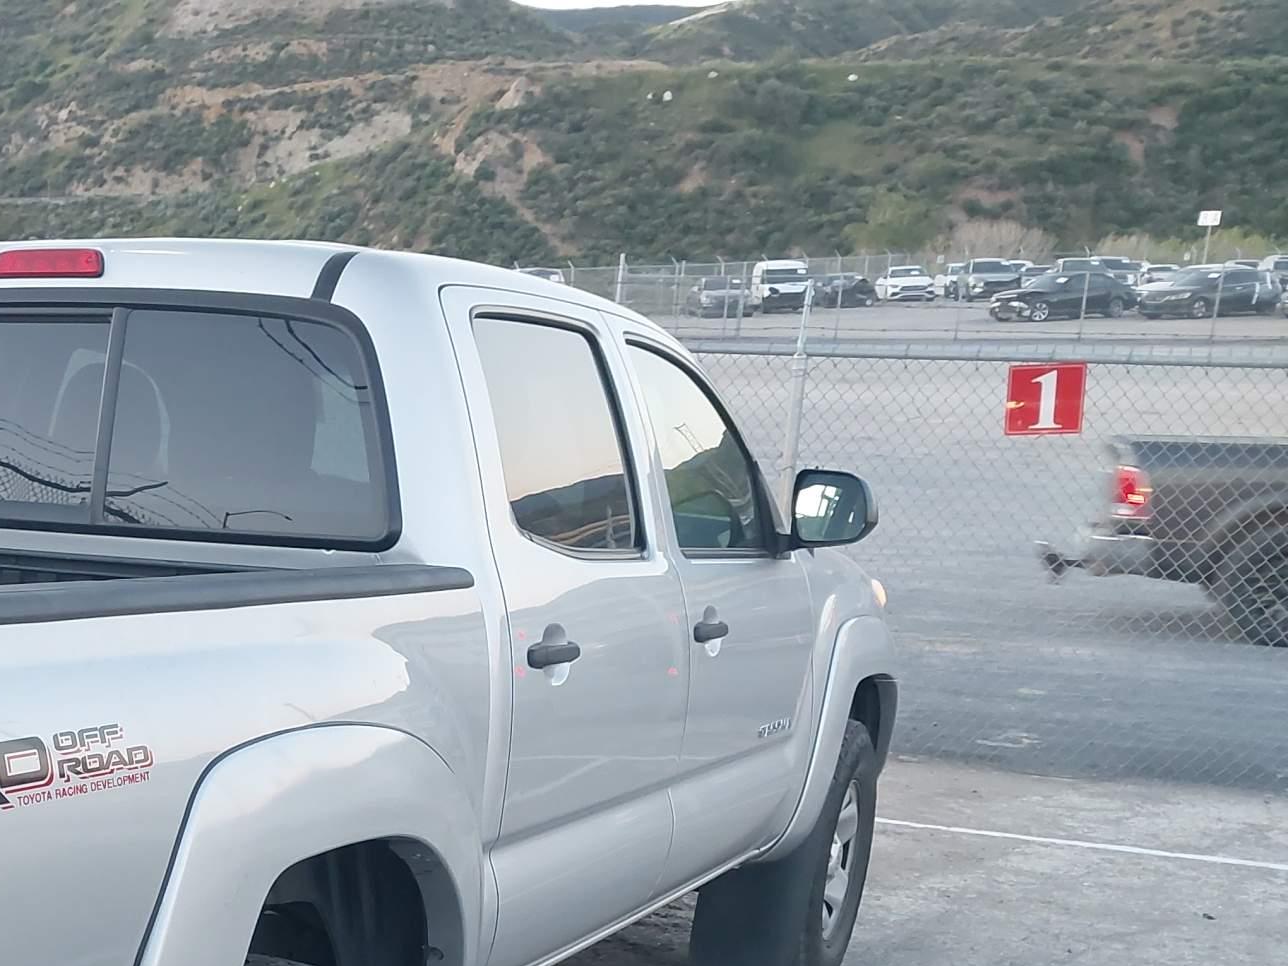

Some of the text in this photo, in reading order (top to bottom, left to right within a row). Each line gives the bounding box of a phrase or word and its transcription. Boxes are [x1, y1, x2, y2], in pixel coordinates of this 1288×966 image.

[1028, 369, 1063, 429] 1
[52, 723, 123, 756] OFF
[57, 745, 153, 782] ROAD
[16, 771, 151, 807] TOYOTA RACING DEVELOPMENT
